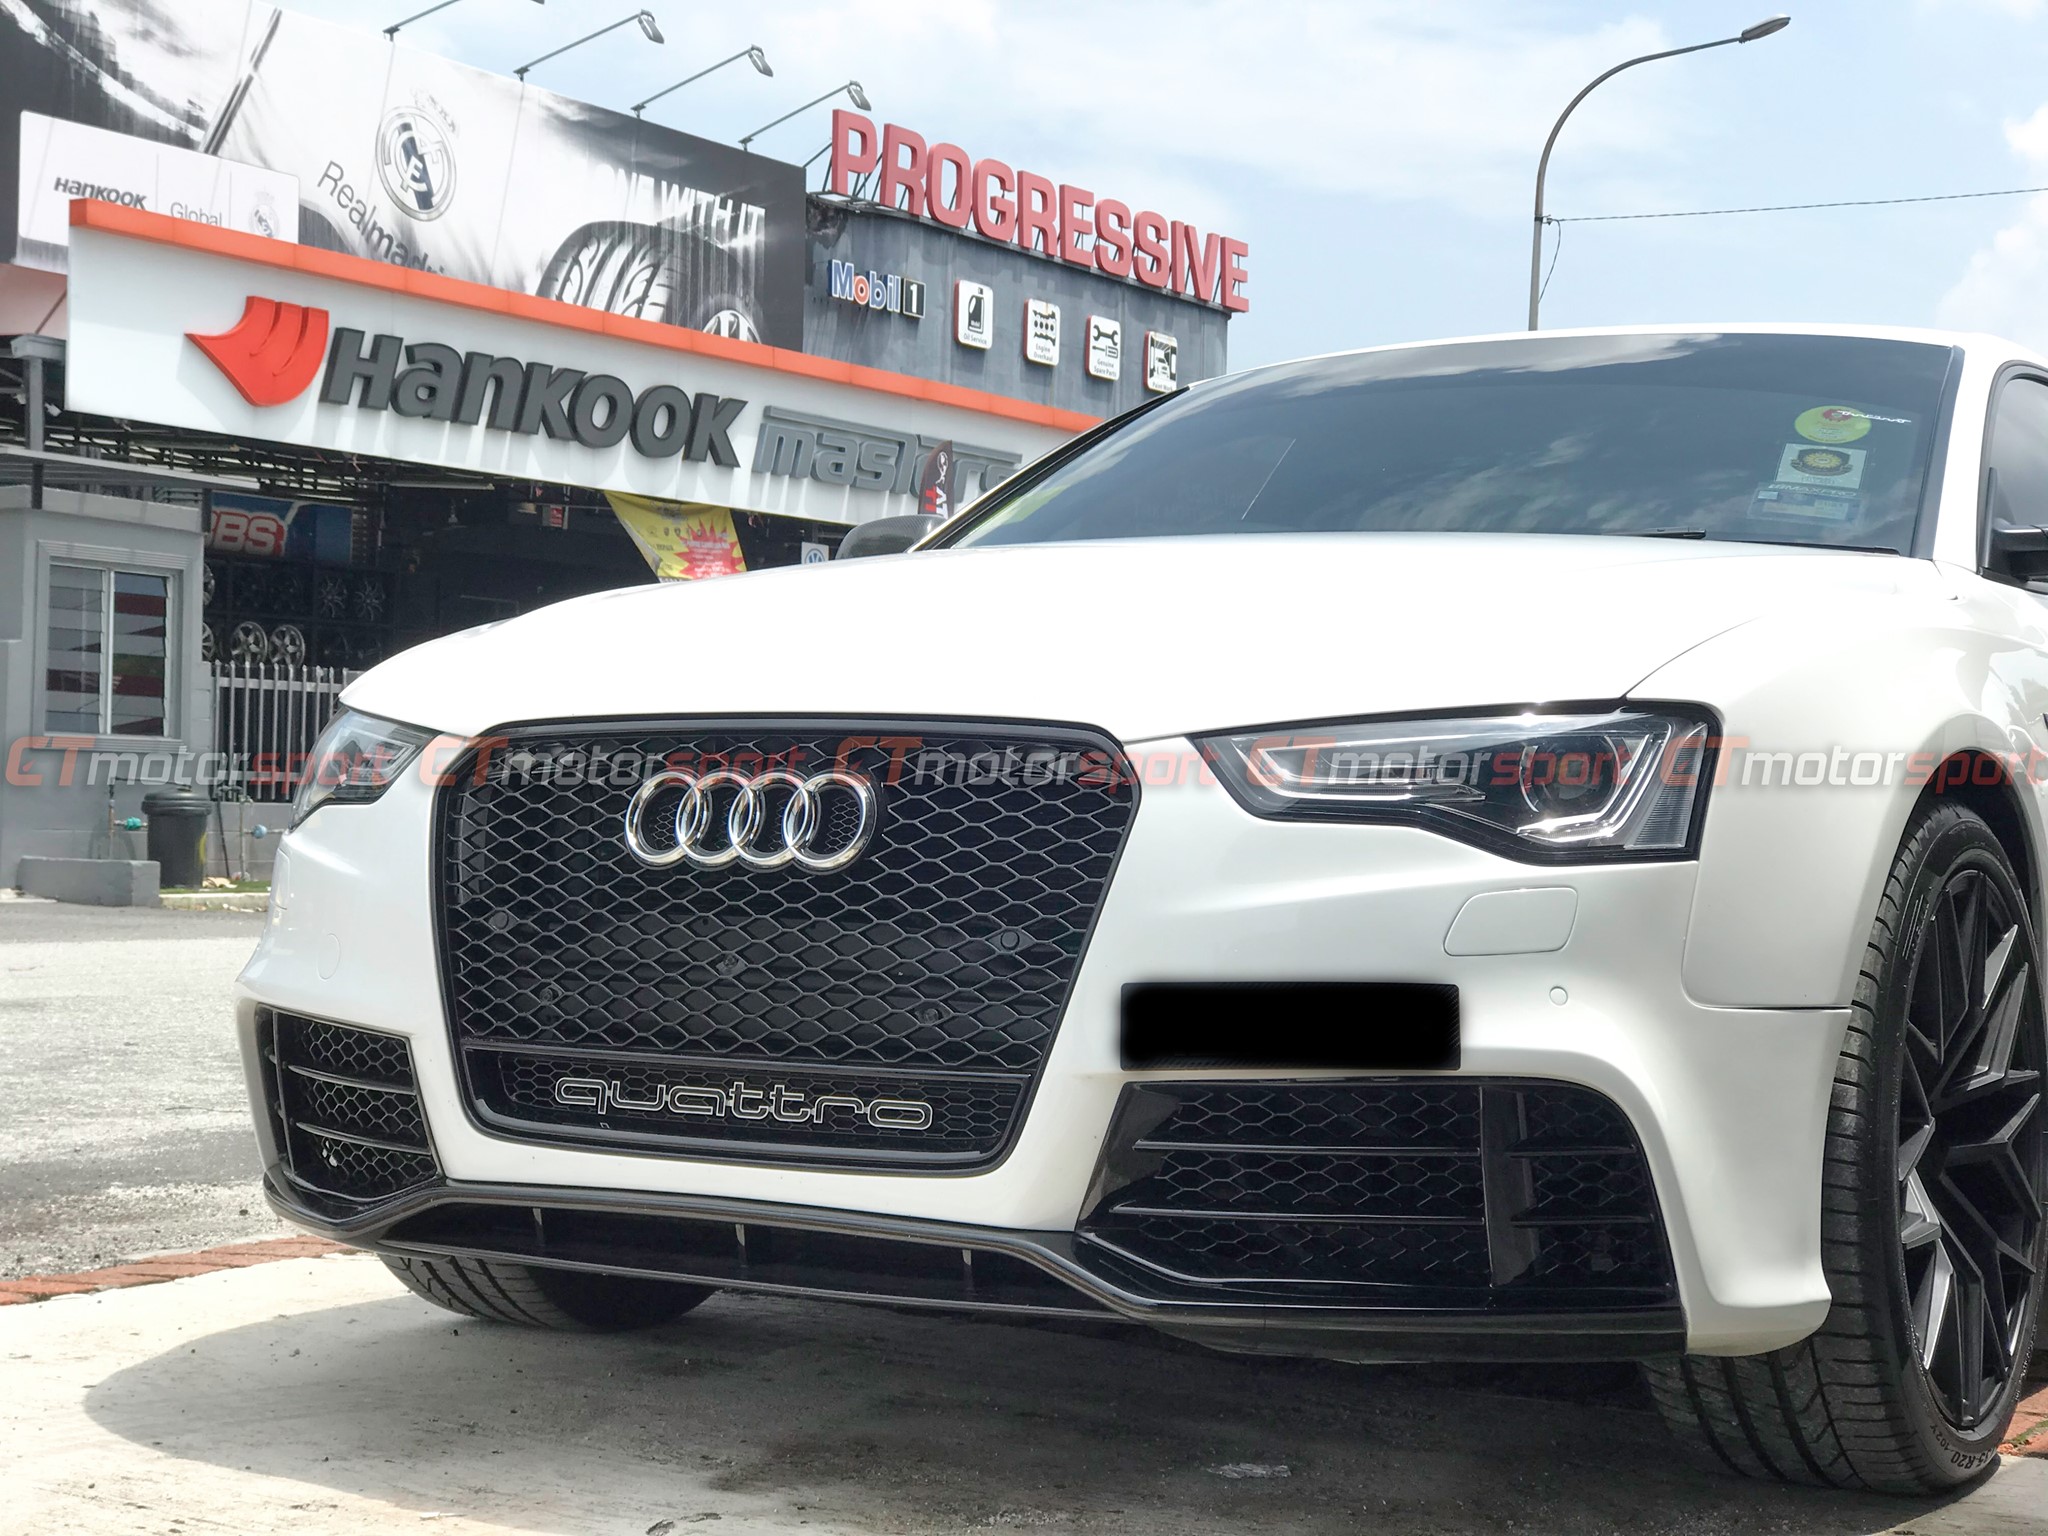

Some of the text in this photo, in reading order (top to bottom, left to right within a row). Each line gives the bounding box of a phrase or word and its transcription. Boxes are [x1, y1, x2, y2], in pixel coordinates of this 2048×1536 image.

[169, 202, 223, 227] Global
[661, 179, 734, 235] WITH
[737, 202, 766, 245] IT
[832, 109, 1249, 312] PROGRESSIVE
[827, 258, 901, 313] Mobil
[971, 335, 987, 345] Service
[1036, 343, 1050, 353] Engine
[1034, 351, 1053, 362] Overhaul
[1097, 359, 1114, 368] Genuine
[1094, 366, 1117, 377] Spare Parts
[210, 508, 286, 556] BS
[555, 1077, 933, 1131] quattro
